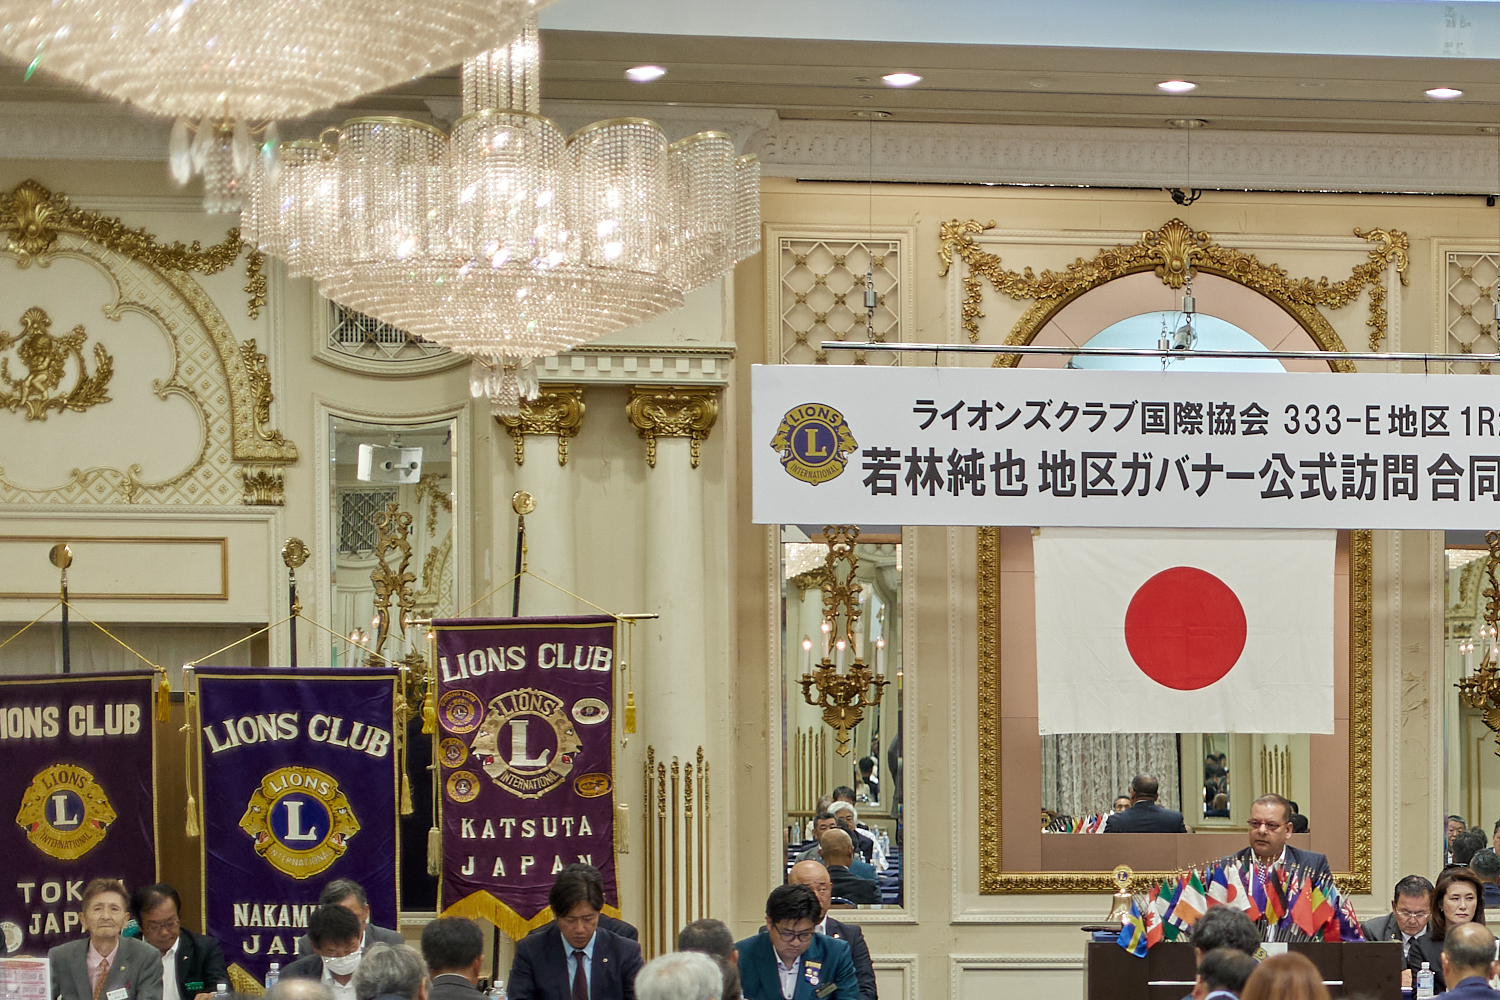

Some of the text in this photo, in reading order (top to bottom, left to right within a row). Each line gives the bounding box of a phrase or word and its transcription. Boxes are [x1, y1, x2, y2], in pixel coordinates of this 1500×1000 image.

[789, 406, 839, 424] LIONS
[912, 398, 1270, 436] ライオンズクラブ国際協会
[805, 428, 827, 456] L
[790, 463, 839, 479] INTERNATIONAL
[440, 643, 613, 682] LIONS CLUB
[497, 694, 556, 716] LIONS
[0, 703, 141, 739] IONS CLUB
[203, 713, 391, 757] LIONS CLUB
[509, 720, 550, 767] L
[42, 770, 88, 790] LIONS
[269, 773, 331, 796] LIONS
[500, 771, 560, 791] INTERNATIONAL
[52, 795, 78, 825] L
[283, 801, 317, 840] L
[461, 815, 593, 839] KATSUTA
[39, 832, 93, 850] INTERNATIONAL
[269, 849, 334, 867] INTERNATIONAL
[29, 911, 87, 935] JAP
[233, 903, 322, 928] NAKAM
